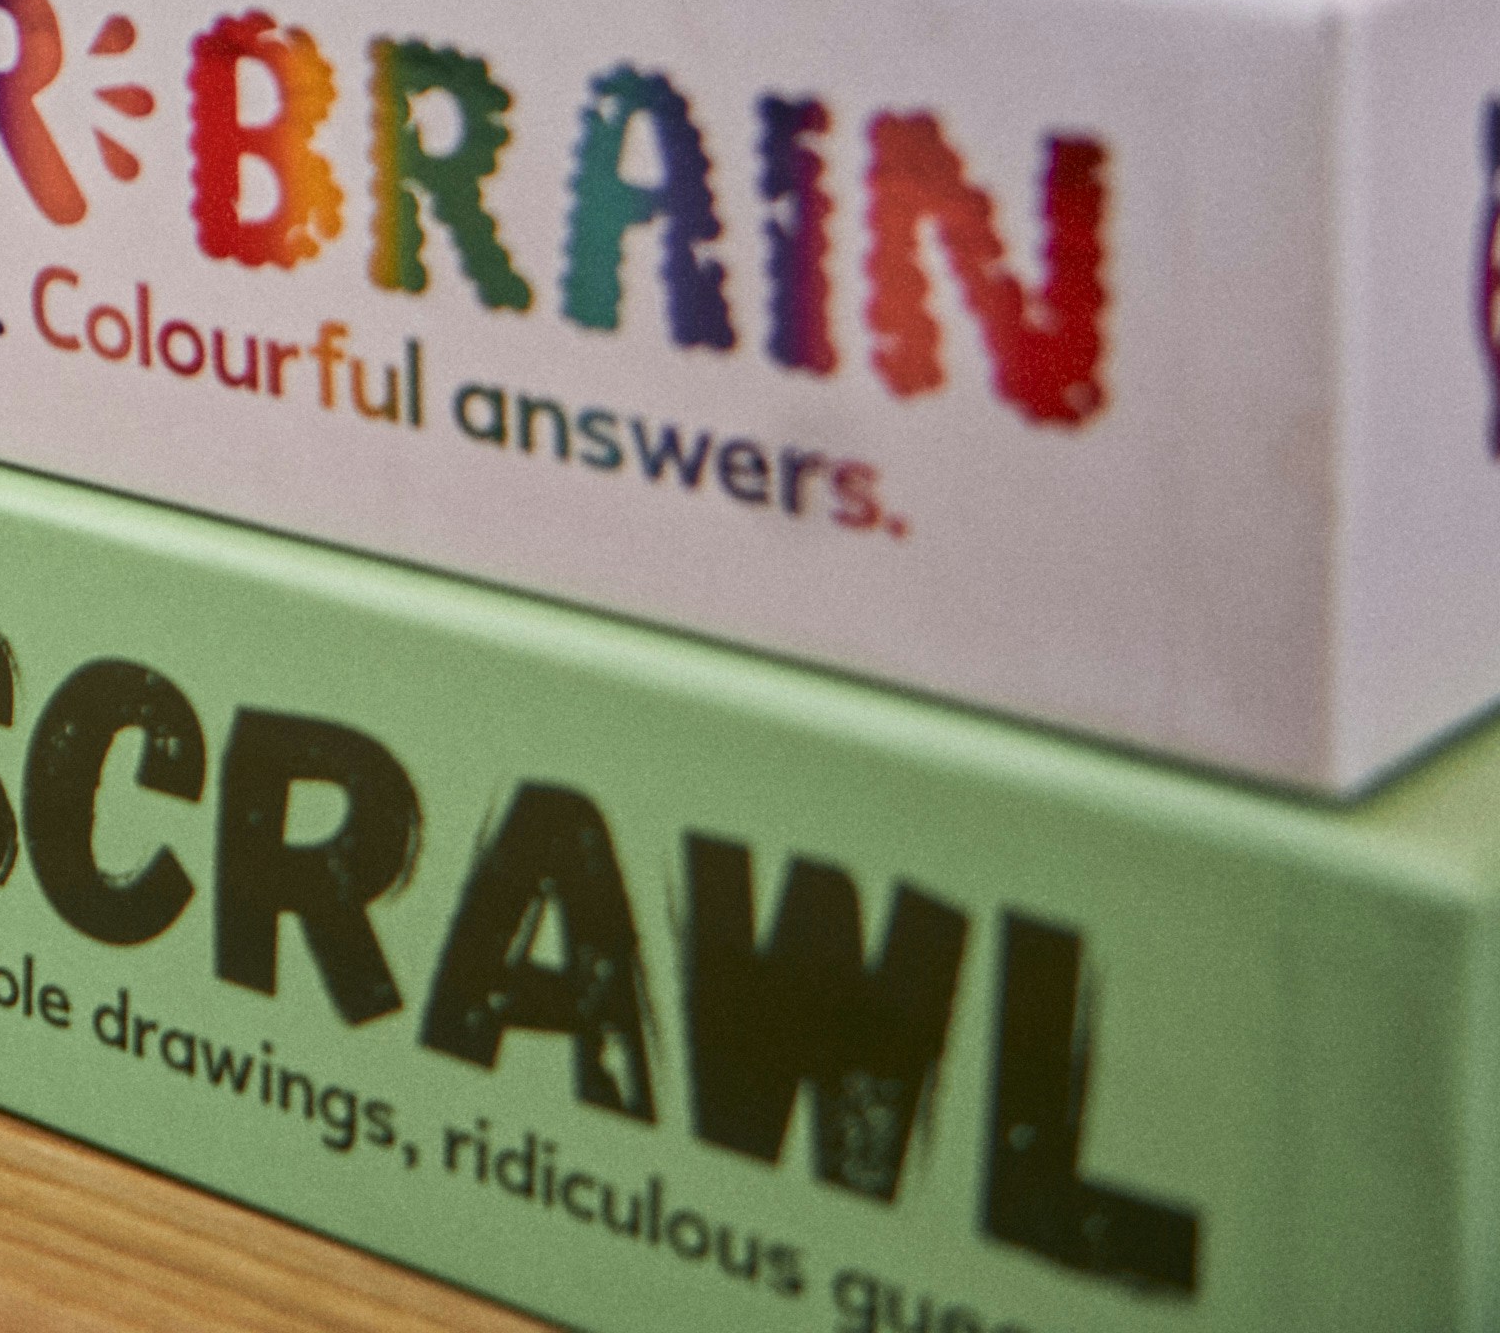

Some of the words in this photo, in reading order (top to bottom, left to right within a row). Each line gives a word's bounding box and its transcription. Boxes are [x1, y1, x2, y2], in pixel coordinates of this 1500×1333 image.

[187, 6, 1109, 429] BRAIN
[30, 263, 426, 430] Colourful
[452, 338, 912, 541] answers.
[92, 988, 418, 1170] drawings,
[442, 1115, 803, 1297] ridiculous
